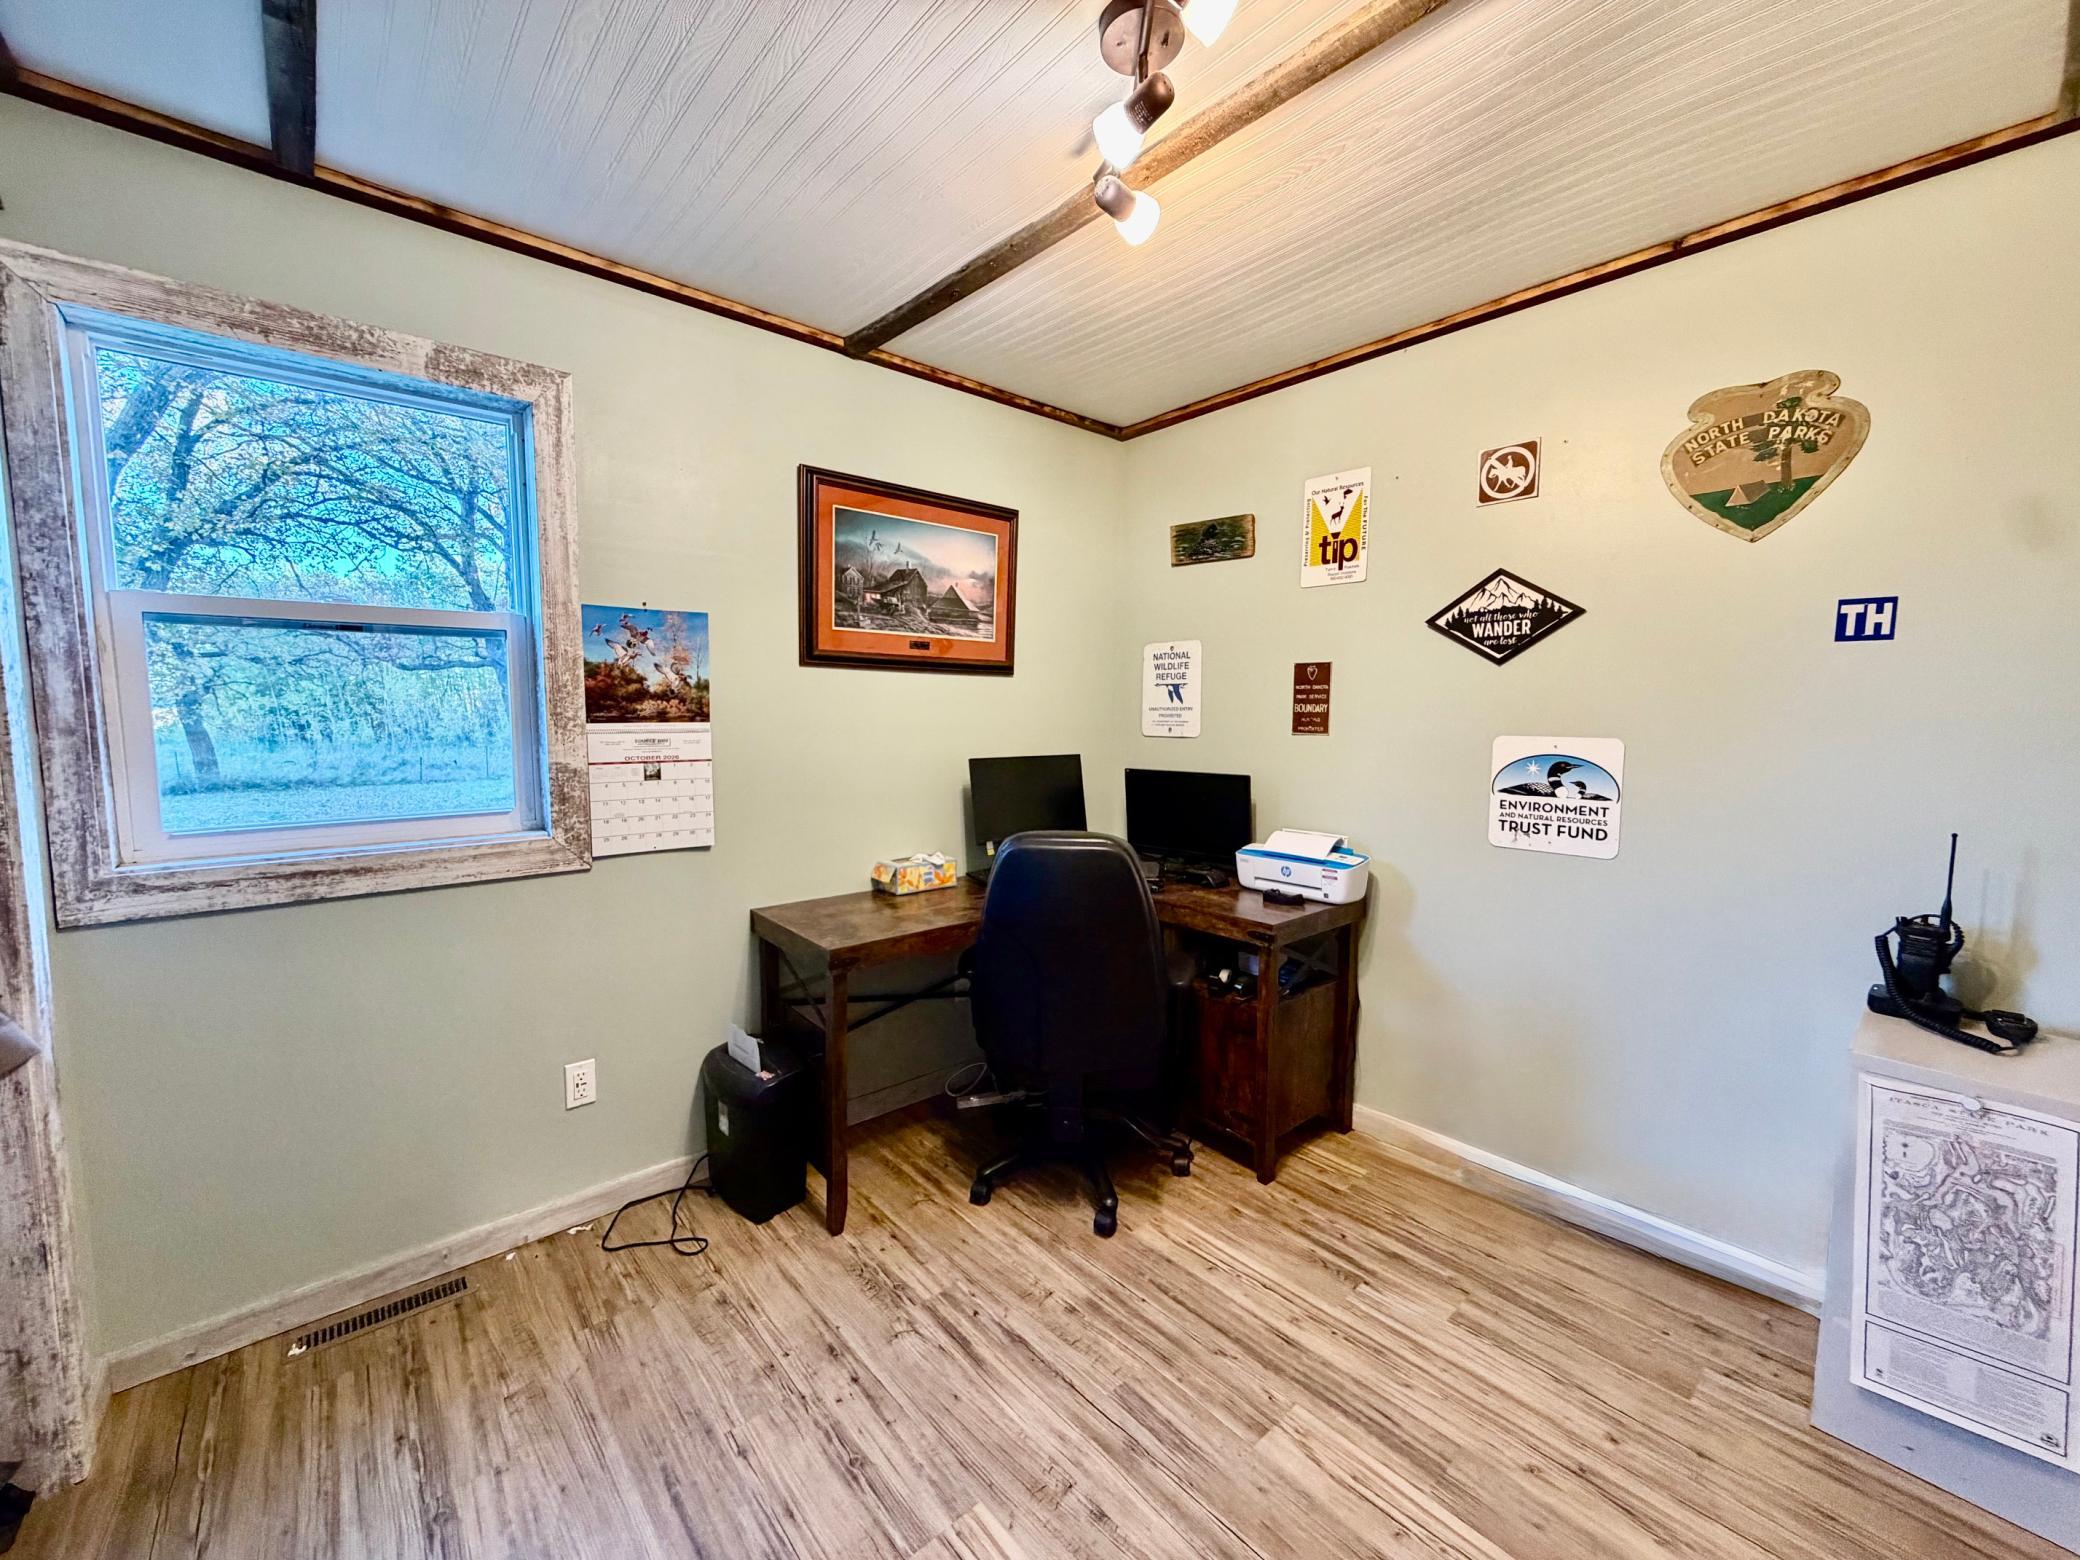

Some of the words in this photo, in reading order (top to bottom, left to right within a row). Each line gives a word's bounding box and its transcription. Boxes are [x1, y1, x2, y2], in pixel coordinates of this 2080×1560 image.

[1686, 418, 1744, 453] NORTH
[1763, 408, 1840, 427] DAKOTA
[1692, 432, 1750, 465] STATE
[1768, 426, 1832, 445] PARKS
[1340, 482, 1364, 490] Resources
[1319, 532, 1358, 570] tip
[1480, 613, 1492, 622] all
[1494, 612, 1516, 620] those
[1519, 609, 1538, 618] who
[1840, 602, 1894, 636] TH
[1472, 619, 1531, 638] WANDER
[1152, 652, 1190, 661] NATIONAL
[1154, 662, 1190, 671] WILDLIFE
[1156, 672, 1187, 680] REFUGE
[1294, 704, 1328, 712] BOUNDARY
[1500, 800, 1610, 817] ENVIRONMENT
[1518, 813, 1554, 822] NATURAL
[1556, 816, 1608, 826] RESOURCES
[1498, 820, 1552, 835] TRUST
[1557, 825, 1608, 840] FUND
[2006, 1121, 2048, 1136] PARK
